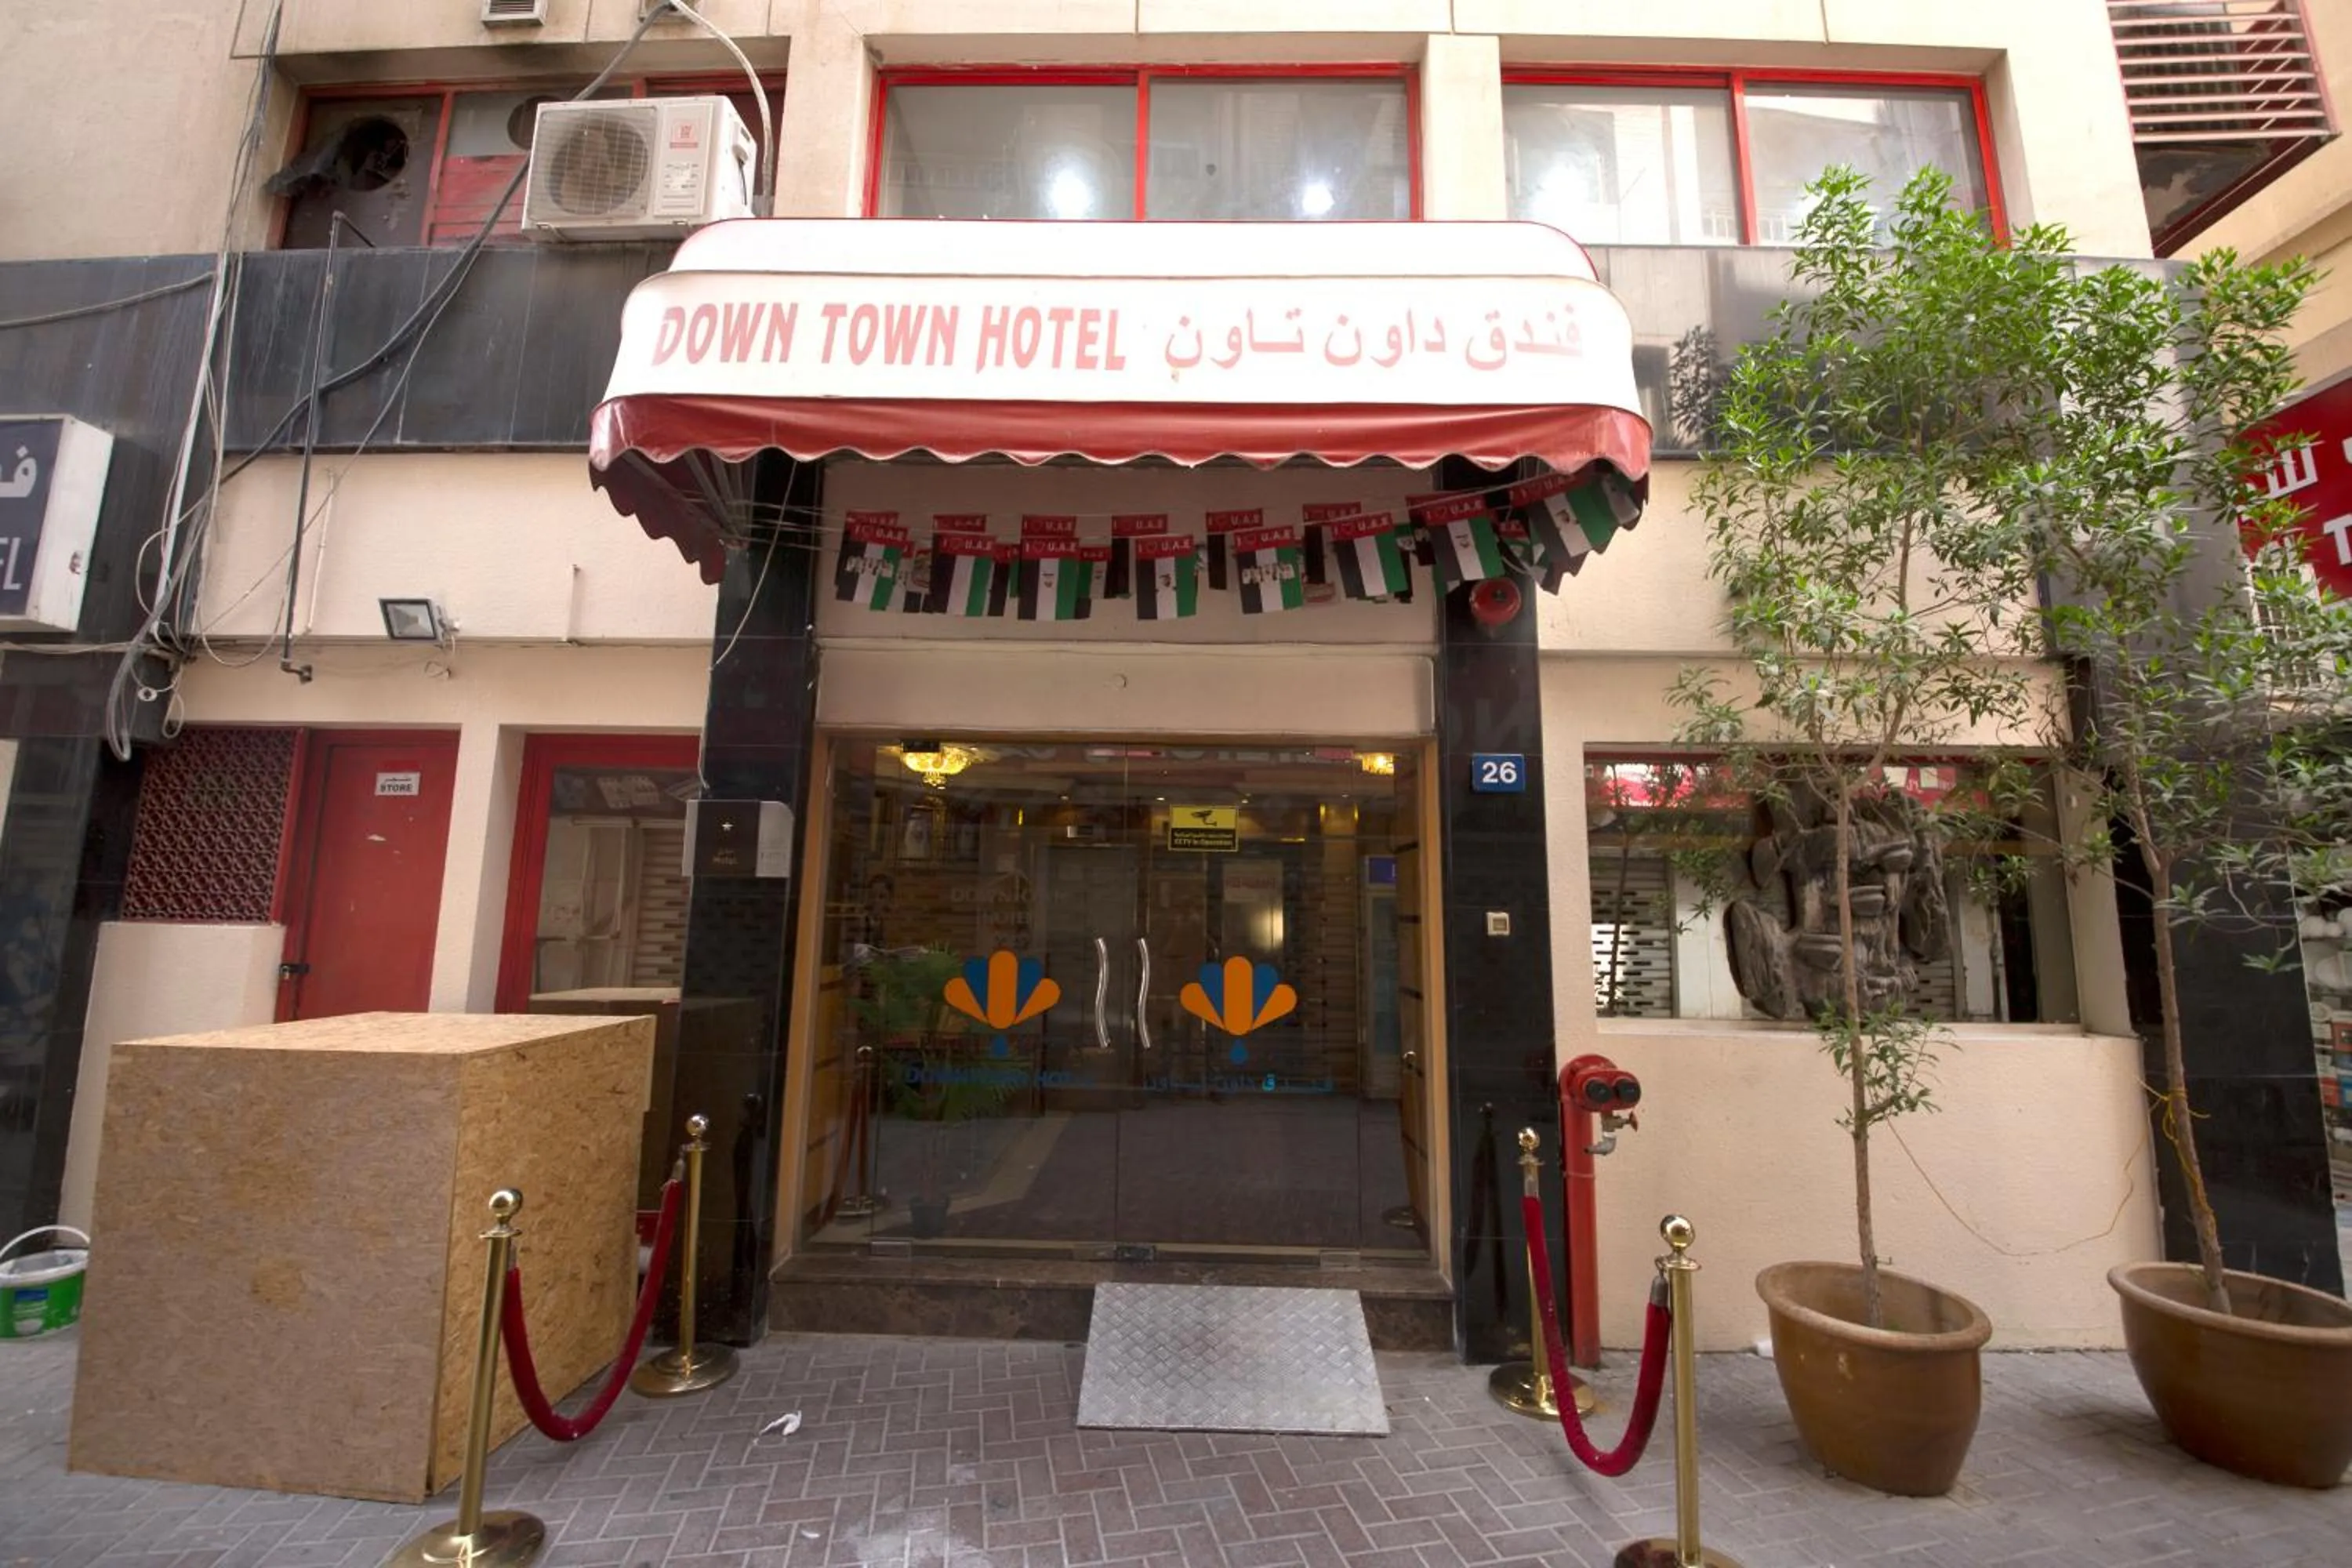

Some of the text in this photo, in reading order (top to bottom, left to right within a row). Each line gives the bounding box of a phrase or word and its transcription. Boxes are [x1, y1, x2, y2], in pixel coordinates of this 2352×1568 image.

[652, 302, 1127, 373] DOWN TOWN HOTEL
[1164, 304, 1584, 373] فندق داون تاون
[379, 783, 413, 793] STORE
[1482, 761, 1518, 784] 26
